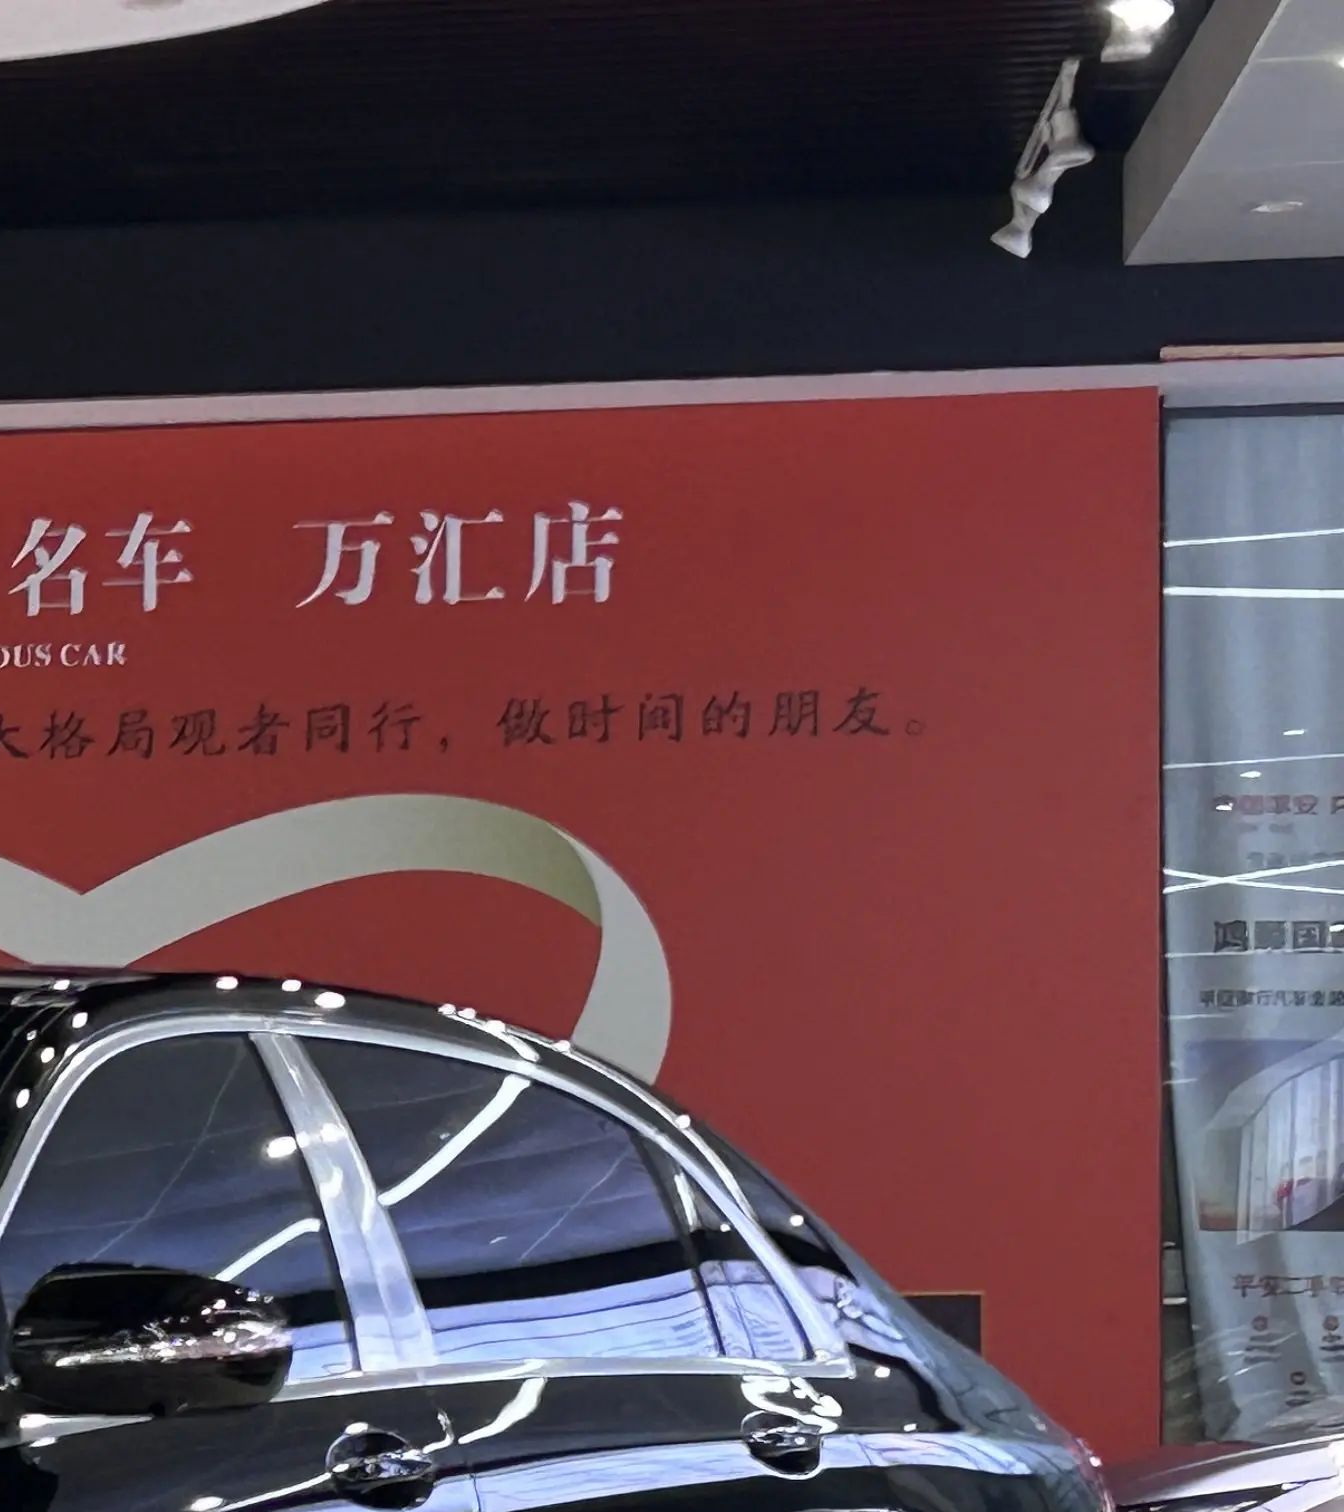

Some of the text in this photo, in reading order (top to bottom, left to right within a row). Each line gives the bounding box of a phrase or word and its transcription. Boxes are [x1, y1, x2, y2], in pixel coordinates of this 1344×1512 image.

[293, 500, 624, 609] 万汇店
[60, 639, 128, 668] CAR
